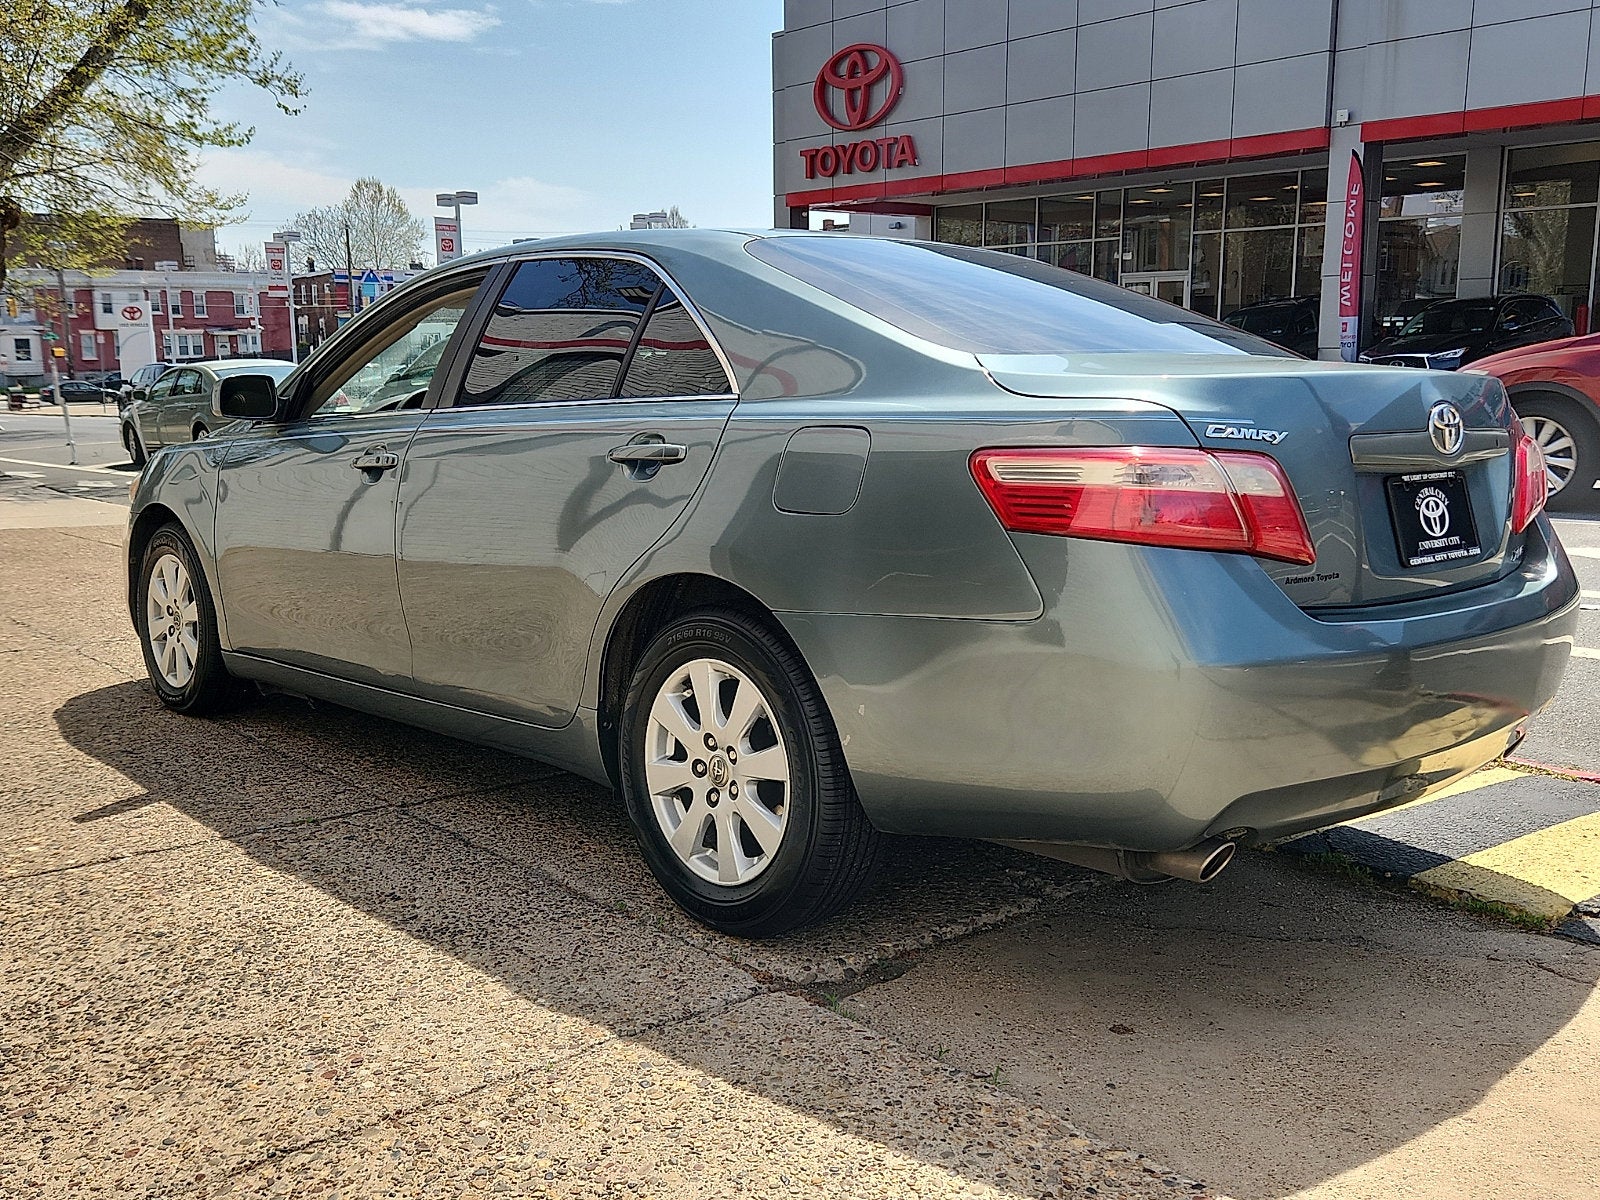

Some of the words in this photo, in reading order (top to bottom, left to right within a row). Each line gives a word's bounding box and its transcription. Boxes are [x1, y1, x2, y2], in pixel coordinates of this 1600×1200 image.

[800, 134, 917, 179] TOYOTA
[1205, 424, 1289, 445] CAMRY
[1414, 487, 1435, 511] CENTRAL
[1435, 488, 1450, 506] CITY
[1418, 538, 1448, 550] UNIVERSITY
[1448, 536, 1460, 546] CITY
[1409, 556, 1435, 566] CENTRAL
[1435, 553, 1447, 561] CITY
[1448, 550, 1468, 559] TOYOTA
[1285, 575, 1315, 585] Ardmore
[1316, 572, 1340, 582] Toyota
[667, 629, 694, 646] 215/60
[695, 628, 713, 638] R16
[713, 631, 732, 644] 95V
